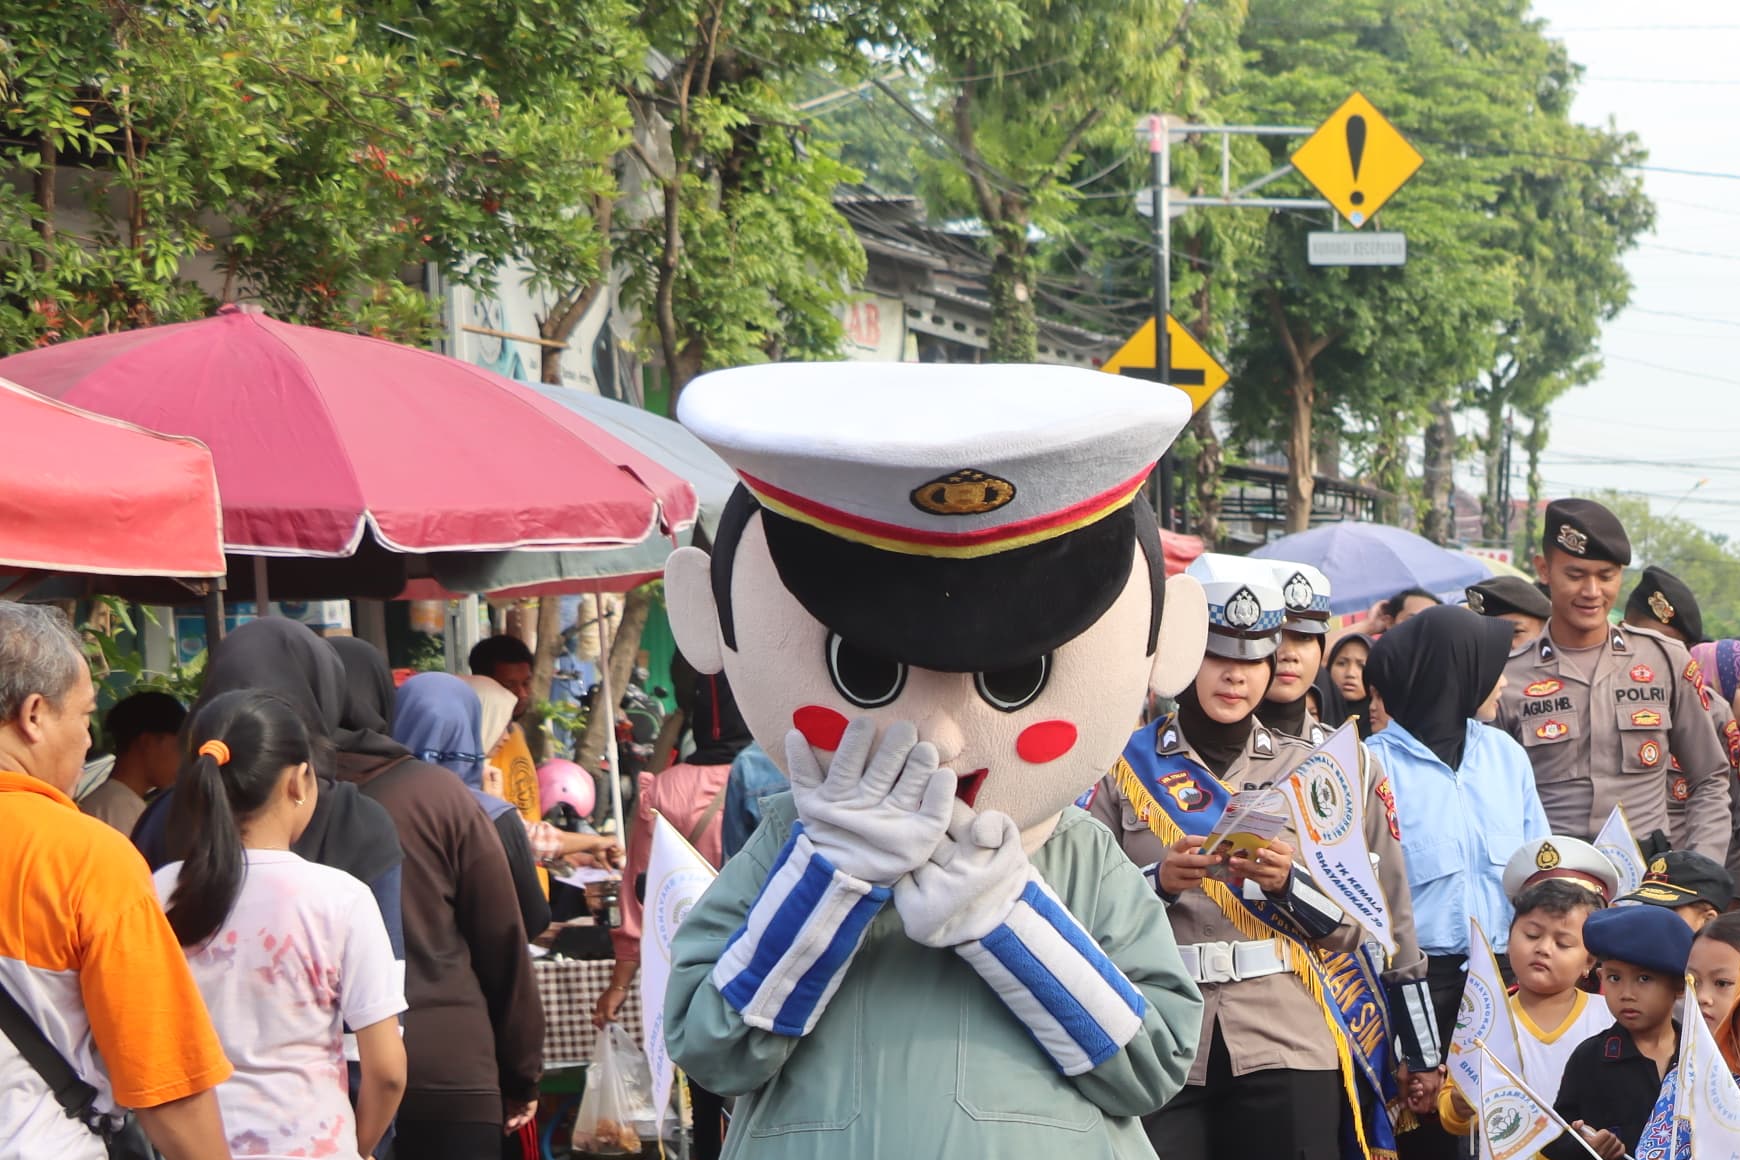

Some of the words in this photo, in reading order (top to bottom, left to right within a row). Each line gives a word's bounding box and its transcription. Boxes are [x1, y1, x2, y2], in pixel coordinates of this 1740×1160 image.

[1522, 699, 1553, 717] AGUS
[1616, 686, 1665, 703] POLRI
[1315, 851, 1372, 918] BHAYANGKARI
[1335, 861, 1349, 880] TK
[1347, 877, 1383, 914] KEMALA
